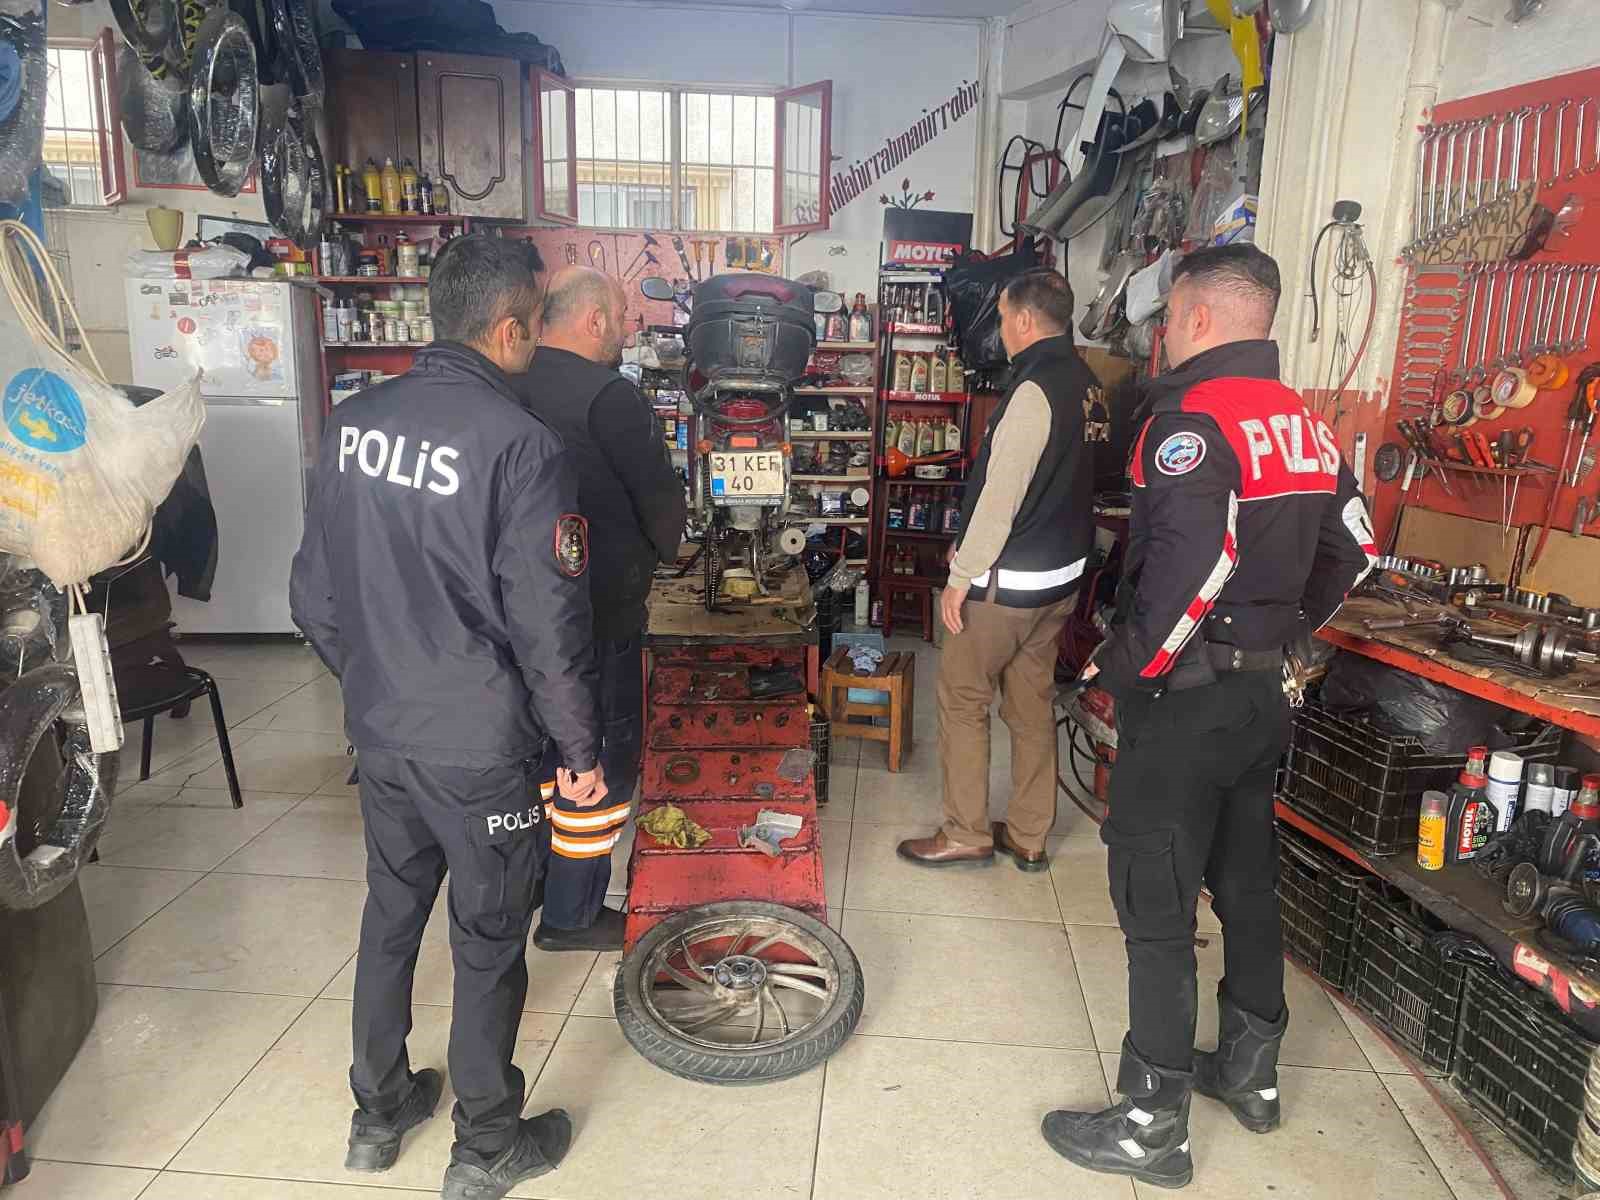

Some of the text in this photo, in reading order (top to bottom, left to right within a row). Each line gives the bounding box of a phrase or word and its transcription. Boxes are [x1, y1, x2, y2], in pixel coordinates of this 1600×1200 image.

[914, 393, 941, 401] MOTUL
[714, 456, 736, 472] 31
[1461, 804, 1476, 849] MOTUL
